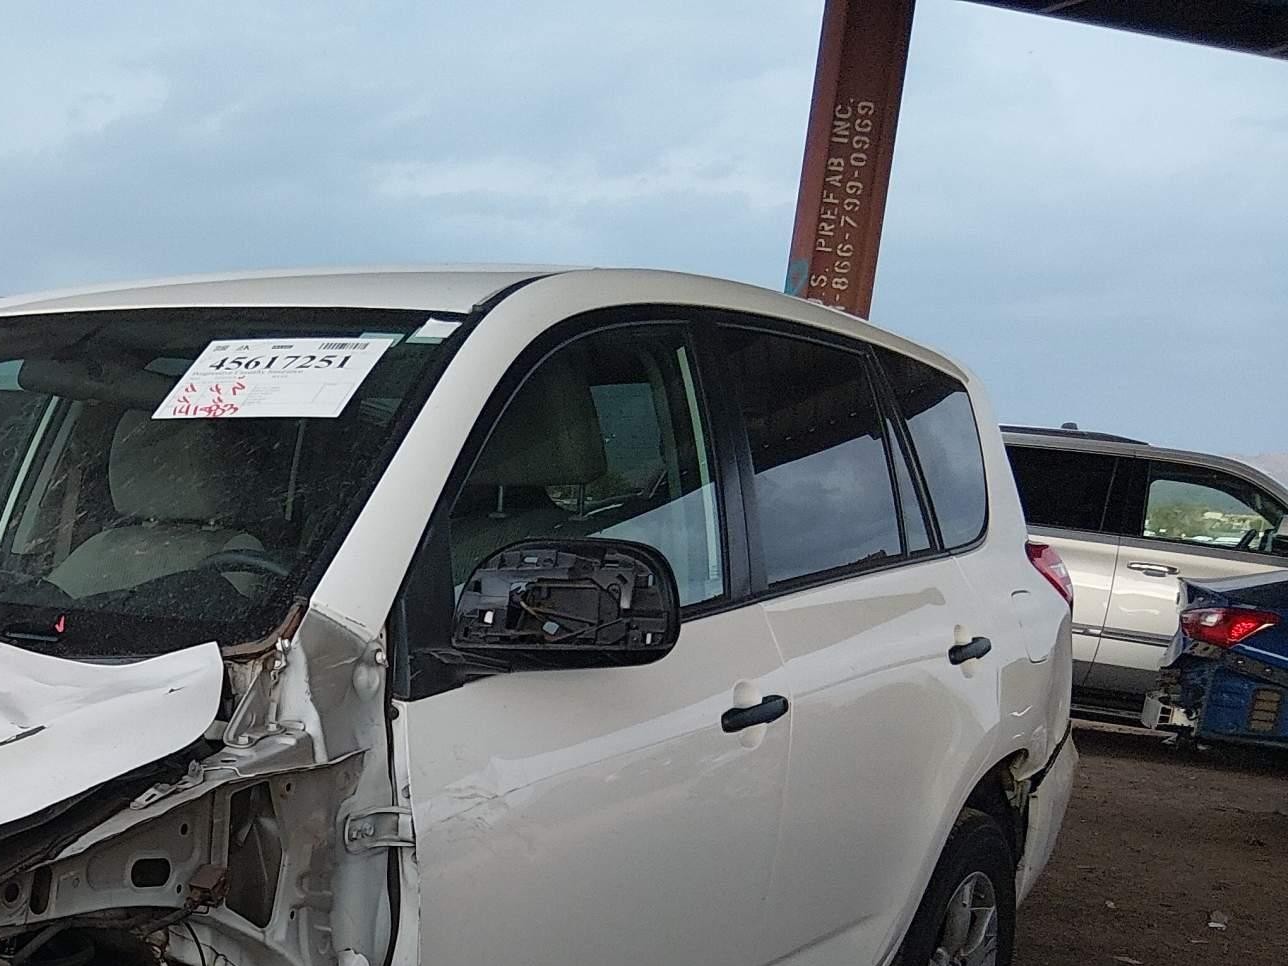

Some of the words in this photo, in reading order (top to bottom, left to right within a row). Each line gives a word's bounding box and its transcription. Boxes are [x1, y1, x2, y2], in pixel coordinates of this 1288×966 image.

[816, 156, 845, 252] PREFAB
[831, 97, 854, 144] INC.
[208, 354, 353, 371] 45617251
